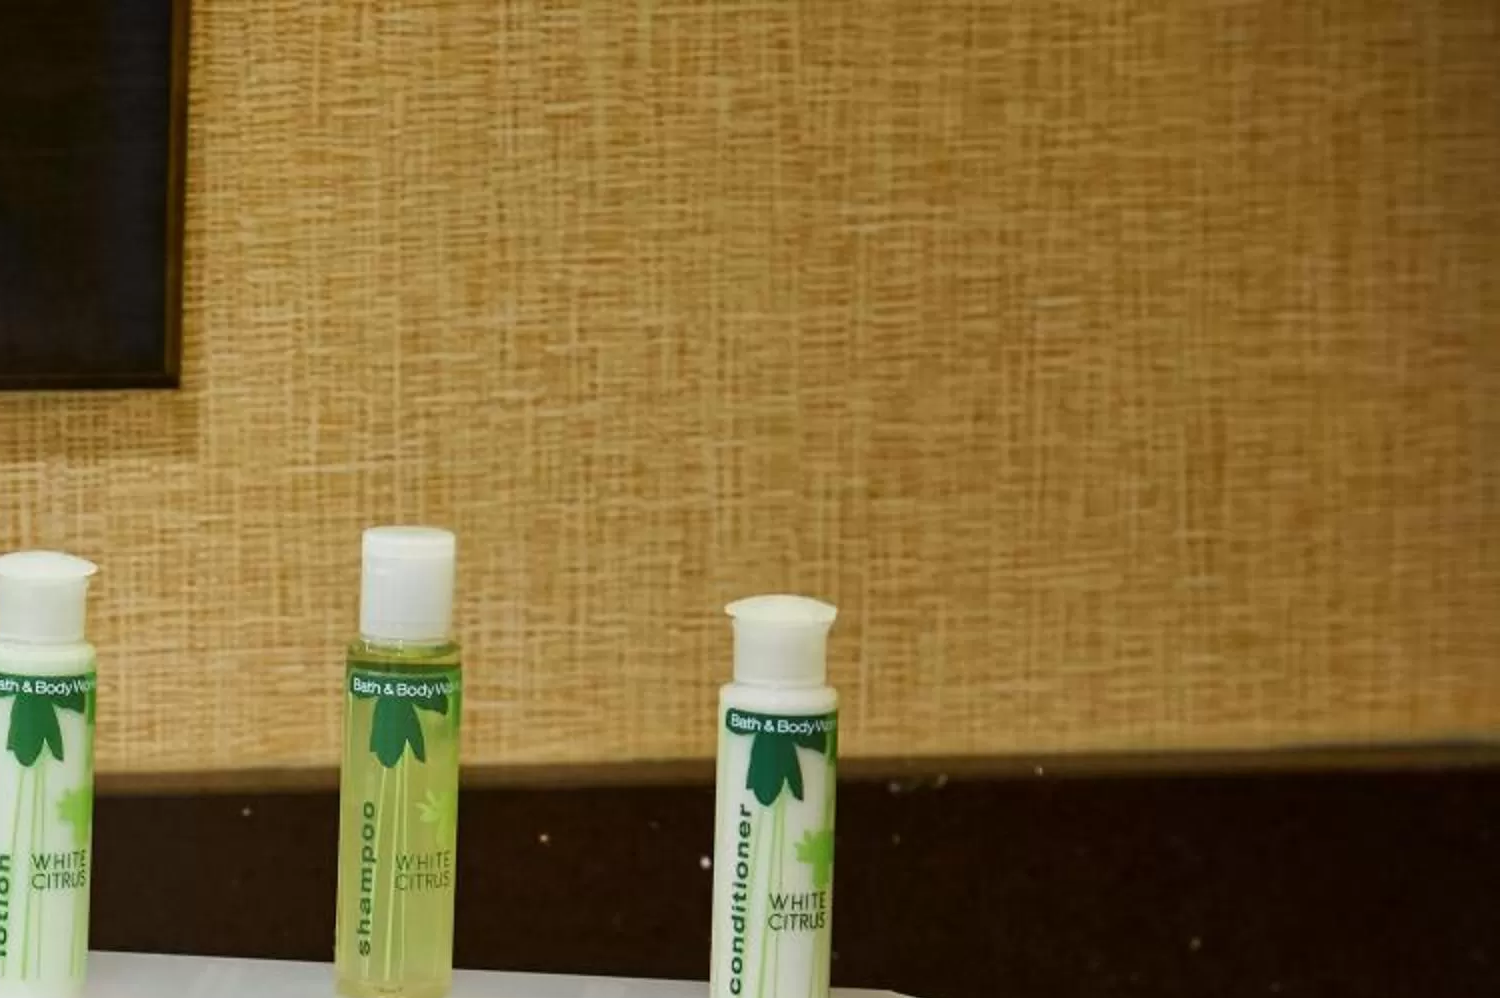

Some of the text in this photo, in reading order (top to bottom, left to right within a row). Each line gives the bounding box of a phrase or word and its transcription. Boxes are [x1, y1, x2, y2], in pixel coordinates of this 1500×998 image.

[21, 680, 33, 693] &
[35, 680, 72, 696] Body
[353, 677, 381, 694] Bath
[383, 683, 394, 695] &
[396, 683, 434, 698] Body
[731, 713, 760, 731] Bath
[764, 719, 775, 732] &
[777, 719, 814, 736] Body
[30, 848, 87, 870] WHITE
[395, 850, 451, 870] WHITE
[31, 868, 86, 891] CITRUS
[356, 801, 376, 957] shampoo
[394, 869, 450, 891] CITRUS
[729, 803, 752, 996] conditioner
[768, 890, 827, 911] WHITE
[767, 911, 825, 932] CITRUS
